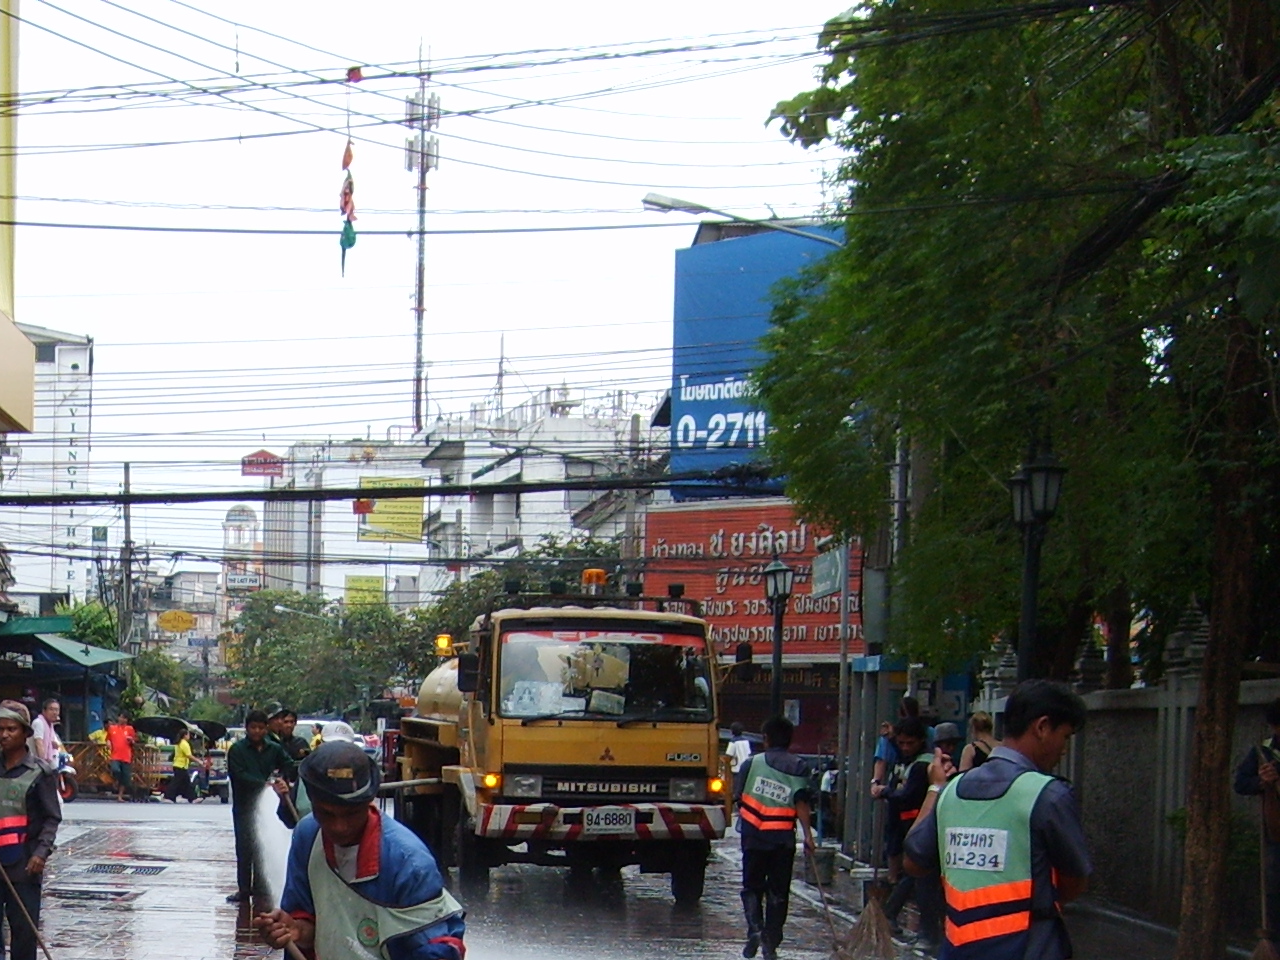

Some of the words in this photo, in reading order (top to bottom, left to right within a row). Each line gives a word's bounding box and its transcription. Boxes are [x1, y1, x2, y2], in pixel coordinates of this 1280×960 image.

[666, 753, 701, 762] FUSO
[557, 782, 657, 794] MITSUBISHI
[586, 812, 632, 826] 94-6880
[948, 832, 996, 849] พระนคร
[945, 851, 1001, 868] 01-234
